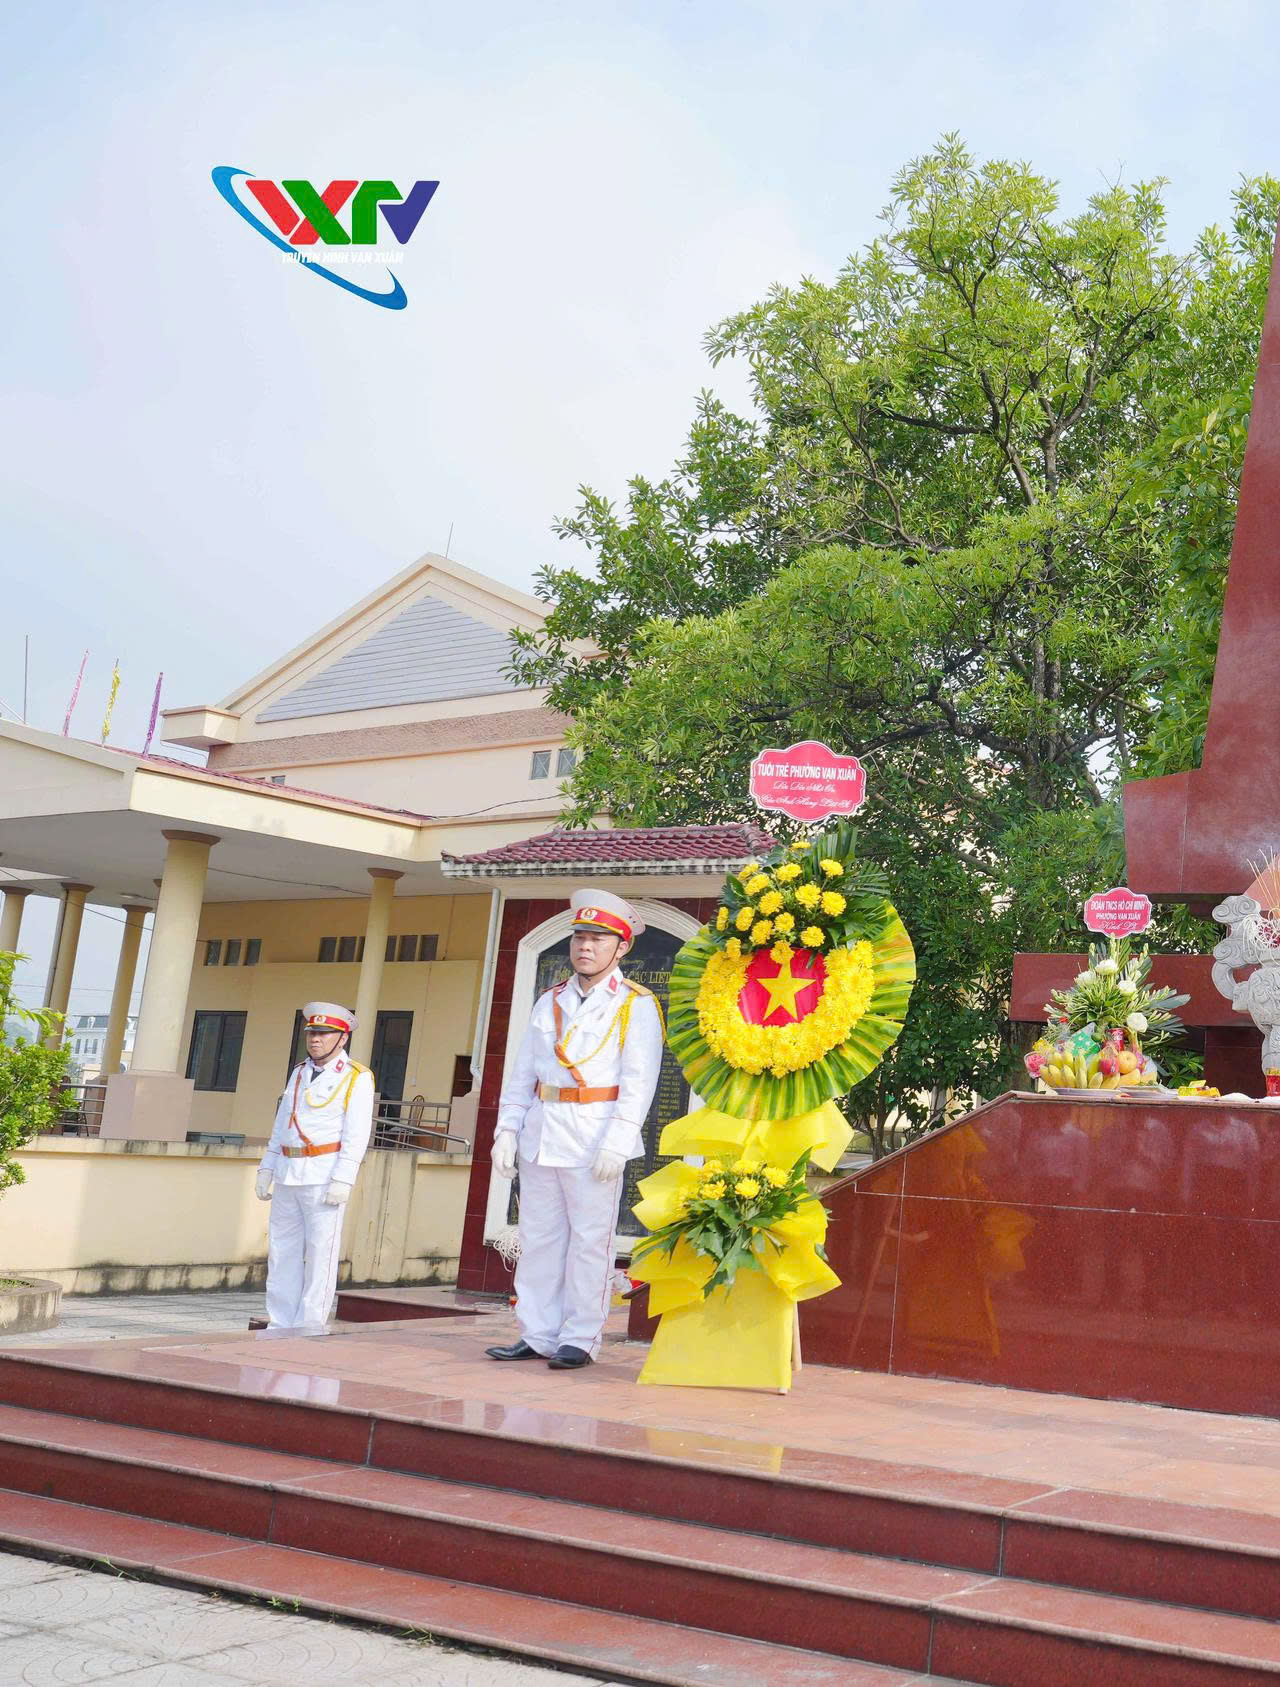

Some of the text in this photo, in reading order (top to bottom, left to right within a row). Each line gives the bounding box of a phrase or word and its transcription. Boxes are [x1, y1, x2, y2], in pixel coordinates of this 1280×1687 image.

[757, 761, 775, 776] TUỔI
[790, 763, 821, 779] PHƯỜNG
[822, 767, 837, 782] VẠN
[837, 765, 857, 781] XUÂN
